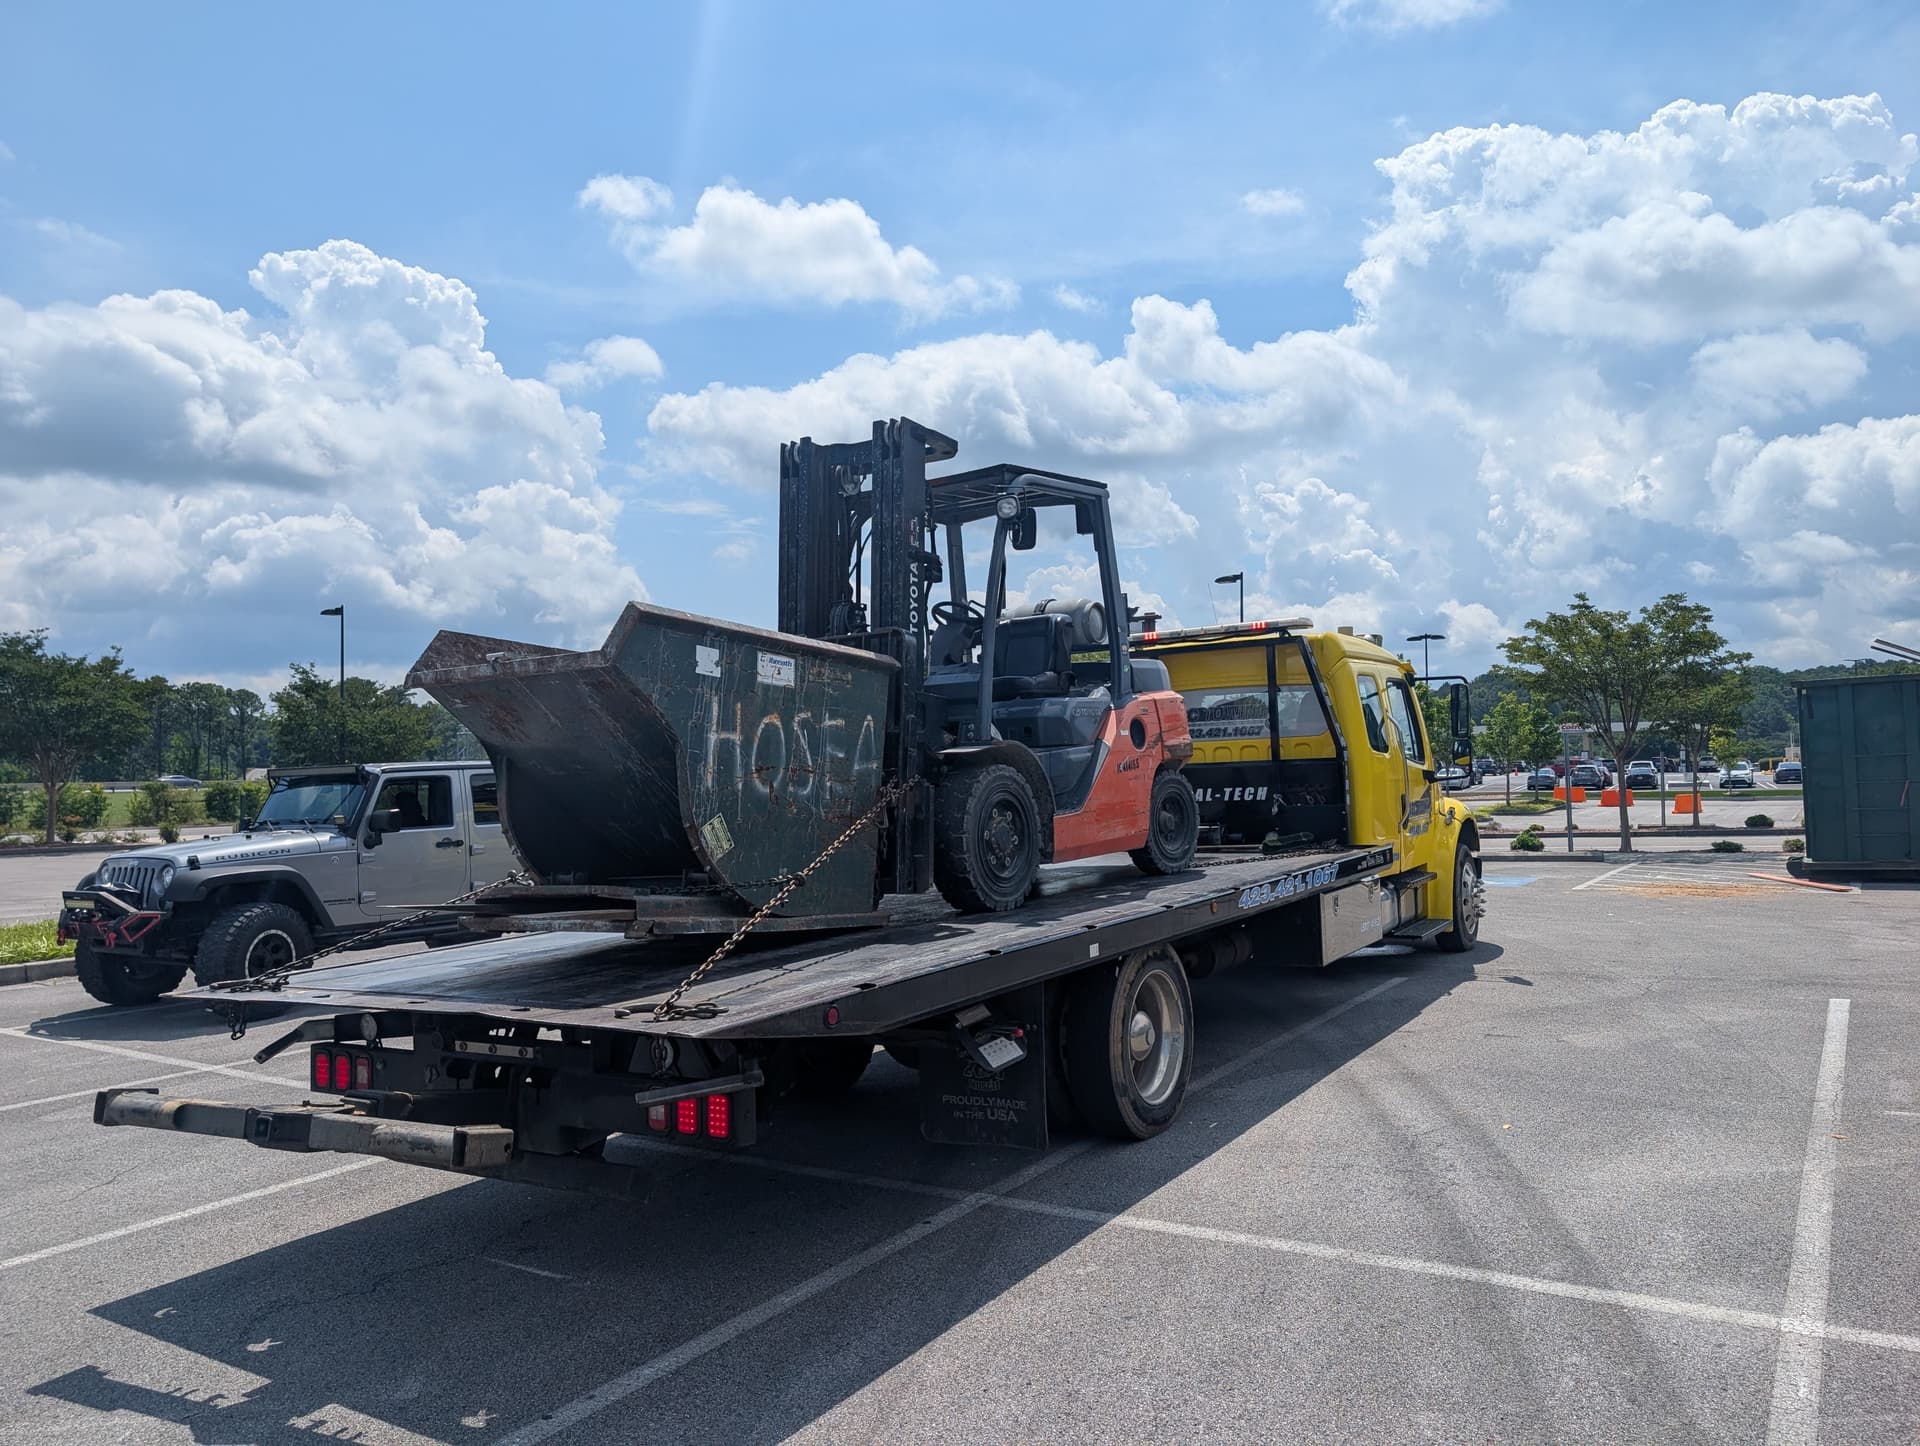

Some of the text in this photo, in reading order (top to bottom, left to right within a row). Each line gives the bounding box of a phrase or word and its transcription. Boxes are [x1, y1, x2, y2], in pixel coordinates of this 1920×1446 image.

[909, 562, 919, 635] TOYOTA
[1189, 726, 1263, 738] 23.421.1067
[1195, 786, 1268, 801] AL-TECH
[215, 848, 291, 861] RUBICON
[1238, 863, 1339, 909] 423.421.1067
[942, 1095, 1026, 1111] PROUDLY MADE
[965, 1111, 985, 1120] THE
[987, 1107, 1018, 1122] USA
